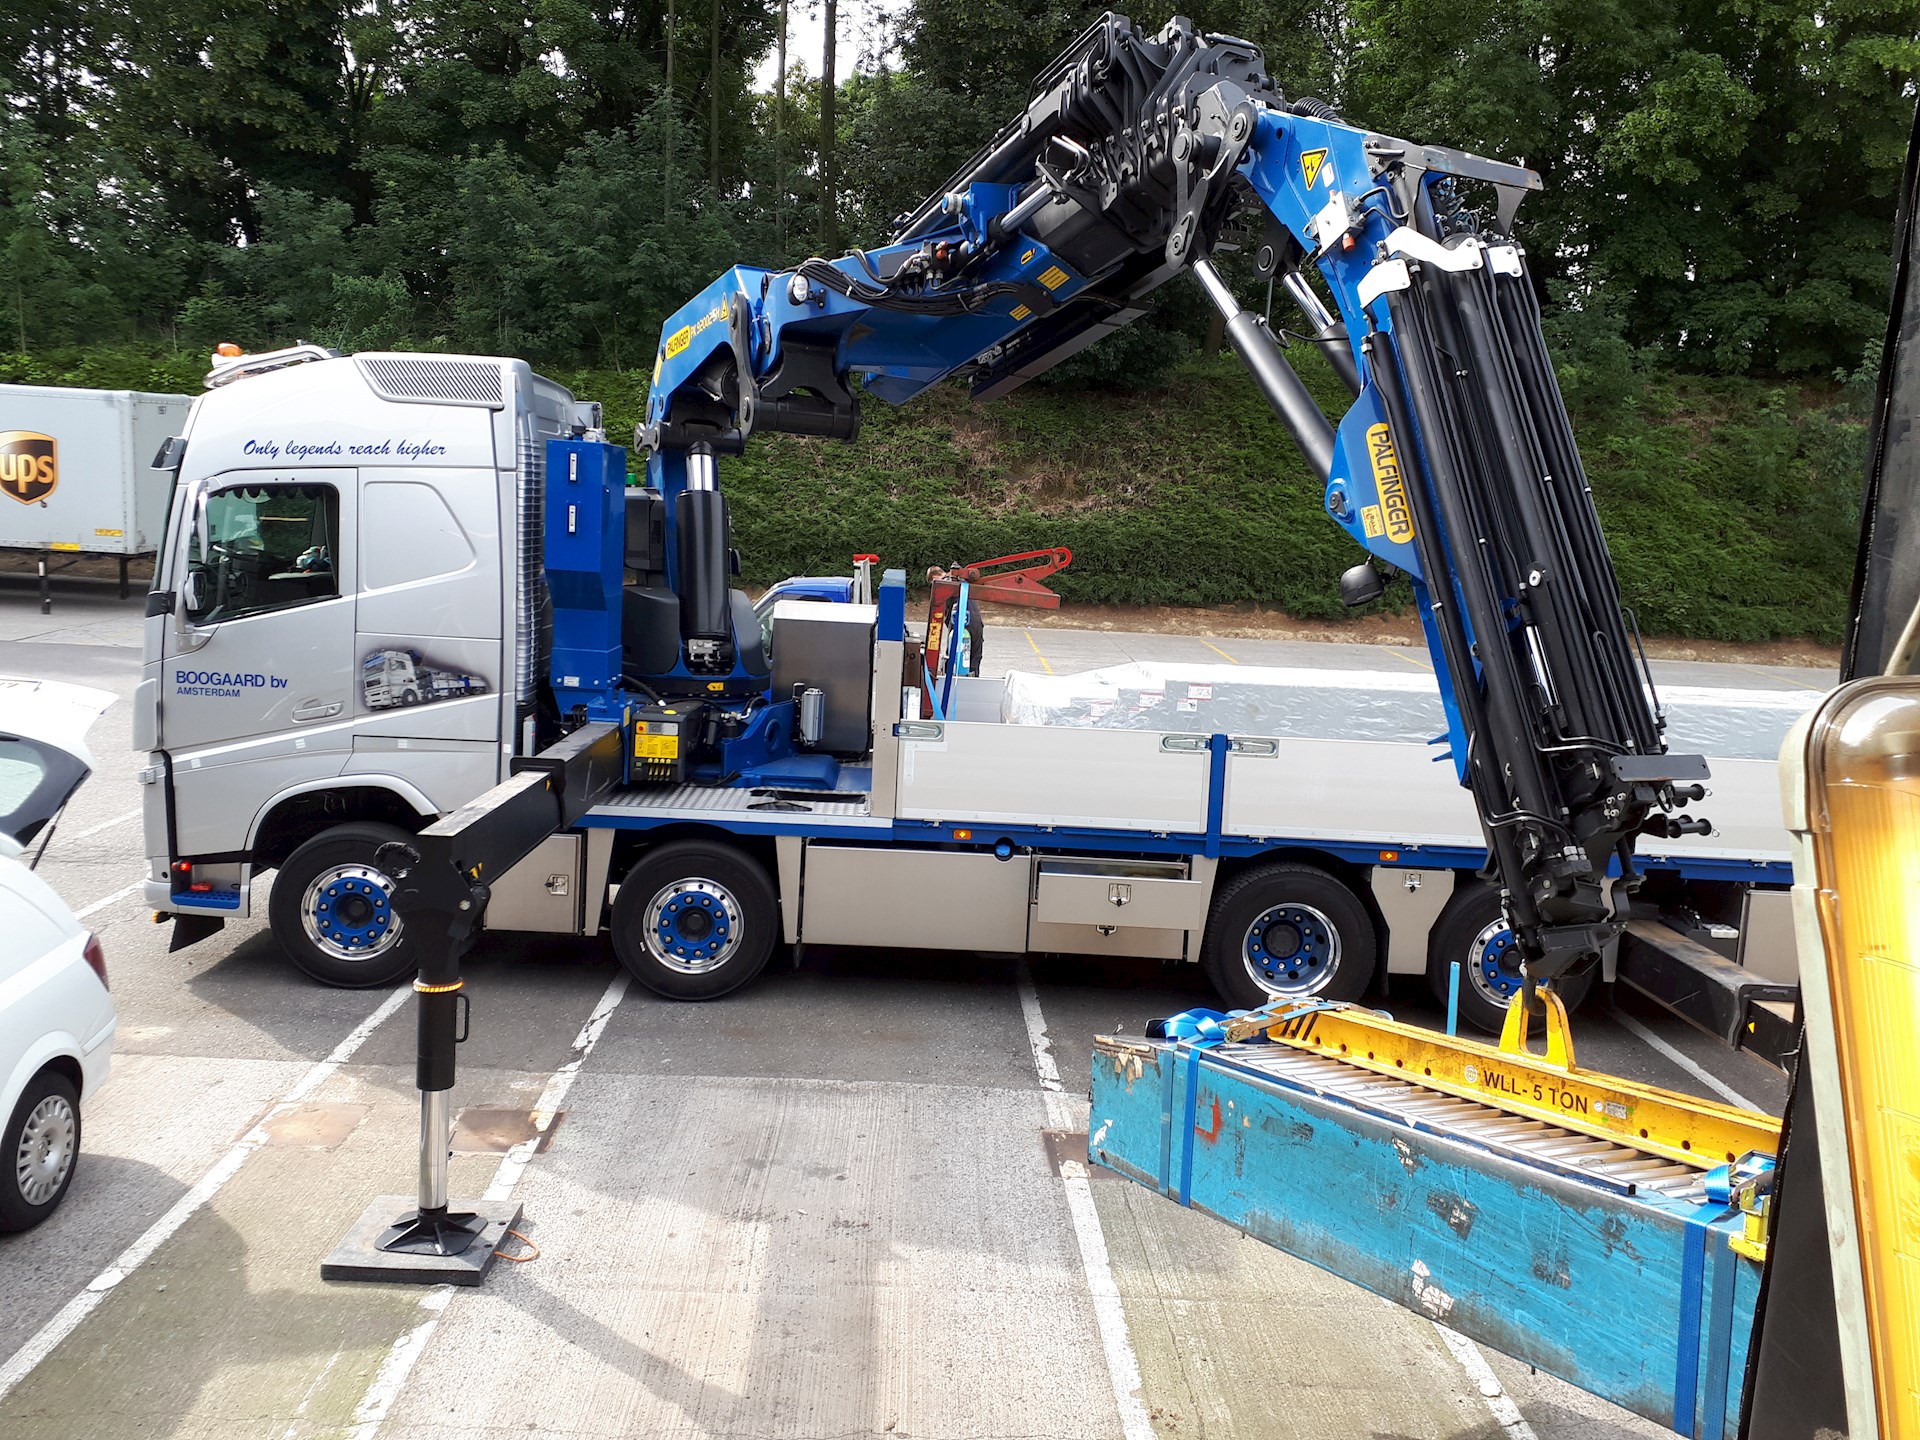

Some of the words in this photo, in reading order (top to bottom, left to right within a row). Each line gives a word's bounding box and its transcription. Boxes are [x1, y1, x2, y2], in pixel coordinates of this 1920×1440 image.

[243, 439, 280, 460] Only
[284, 440, 343, 461] legends
[348, 439, 391, 455] reach
[395, 439, 447, 461] higher
[0, 453, 54, 494] ups
[1371, 430, 1410, 537] PALFINGER
[176, 671, 265, 687] BOOGAARD
[270, 675, 288, 689] bv
[176, 687, 240, 697] AMSTERDAM
[1533, 1084, 1543, 1101] 5
[1549, 1087, 1588, 1114] TON
